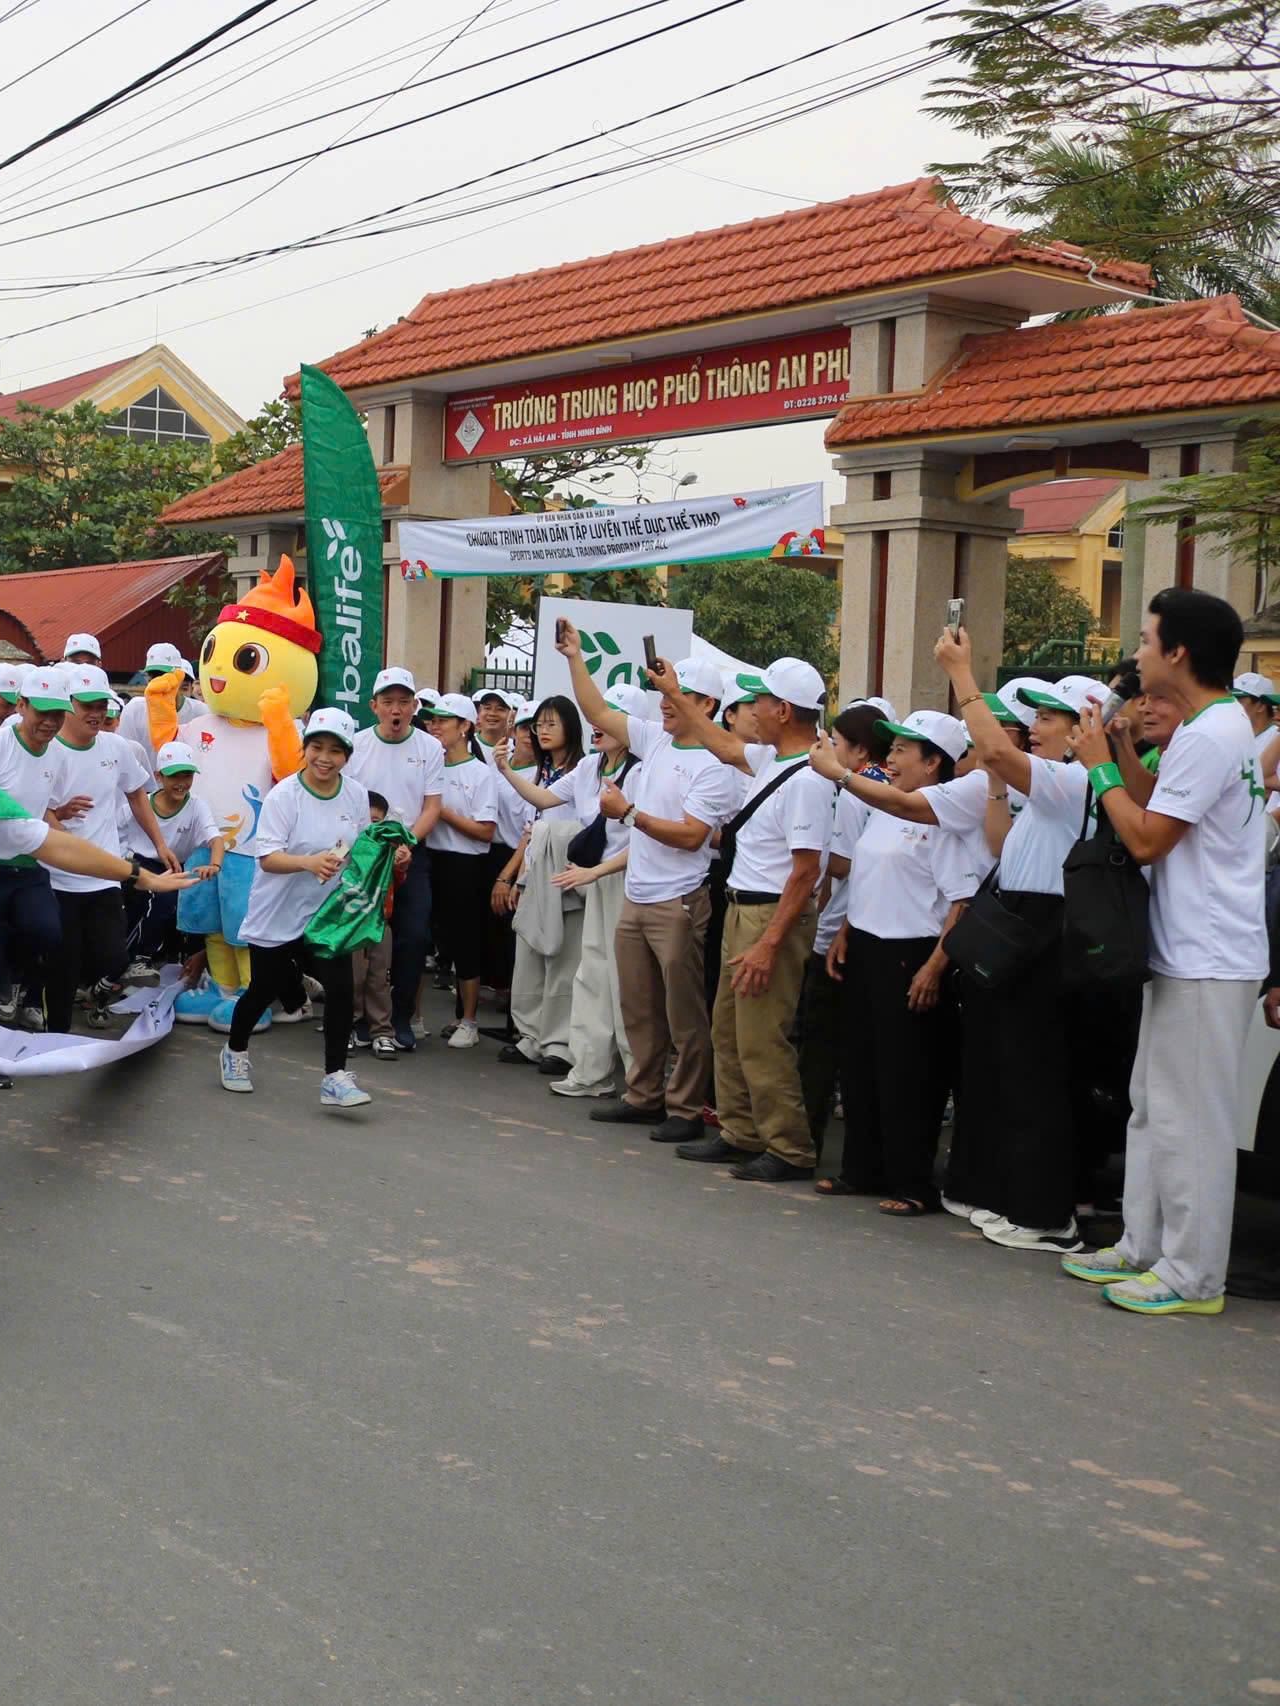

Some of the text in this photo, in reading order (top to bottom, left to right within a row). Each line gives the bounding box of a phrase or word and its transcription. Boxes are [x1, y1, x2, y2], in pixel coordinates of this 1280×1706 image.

[492, 389, 557, 431] TRƯỜNG
[561, 385, 618, 422] TRUNG
[622, 378, 659, 418] HỌC
[663, 356, 702, 407] PHỔ
[706, 357, 771, 401] THÔNG
[776, 353, 808, 391] AN
[546, 433, 557, 442] AN
[499, 527, 525, 546] TRÌNH
[525, 524, 549, 545] TOÀN
[550, 523, 569, 543] DÂN
[569, 521, 588, 543] TẬP
[589, 519, 622, 541] LUYỆN
[622, 512, 644, 537] THỂ
[643, 517, 666, 537] DỤC
[665, 508, 691, 532] THỂ
[689, 511, 720, 529] THAO
[509, 549, 532, 561] SPORTS
[532, 549, 546, 560] AND
[545, 547, 576, 560] PHYSICAL
[575, 544, 607, 558] TRAINING
[607, 541, 641, 555] PROGRAM
